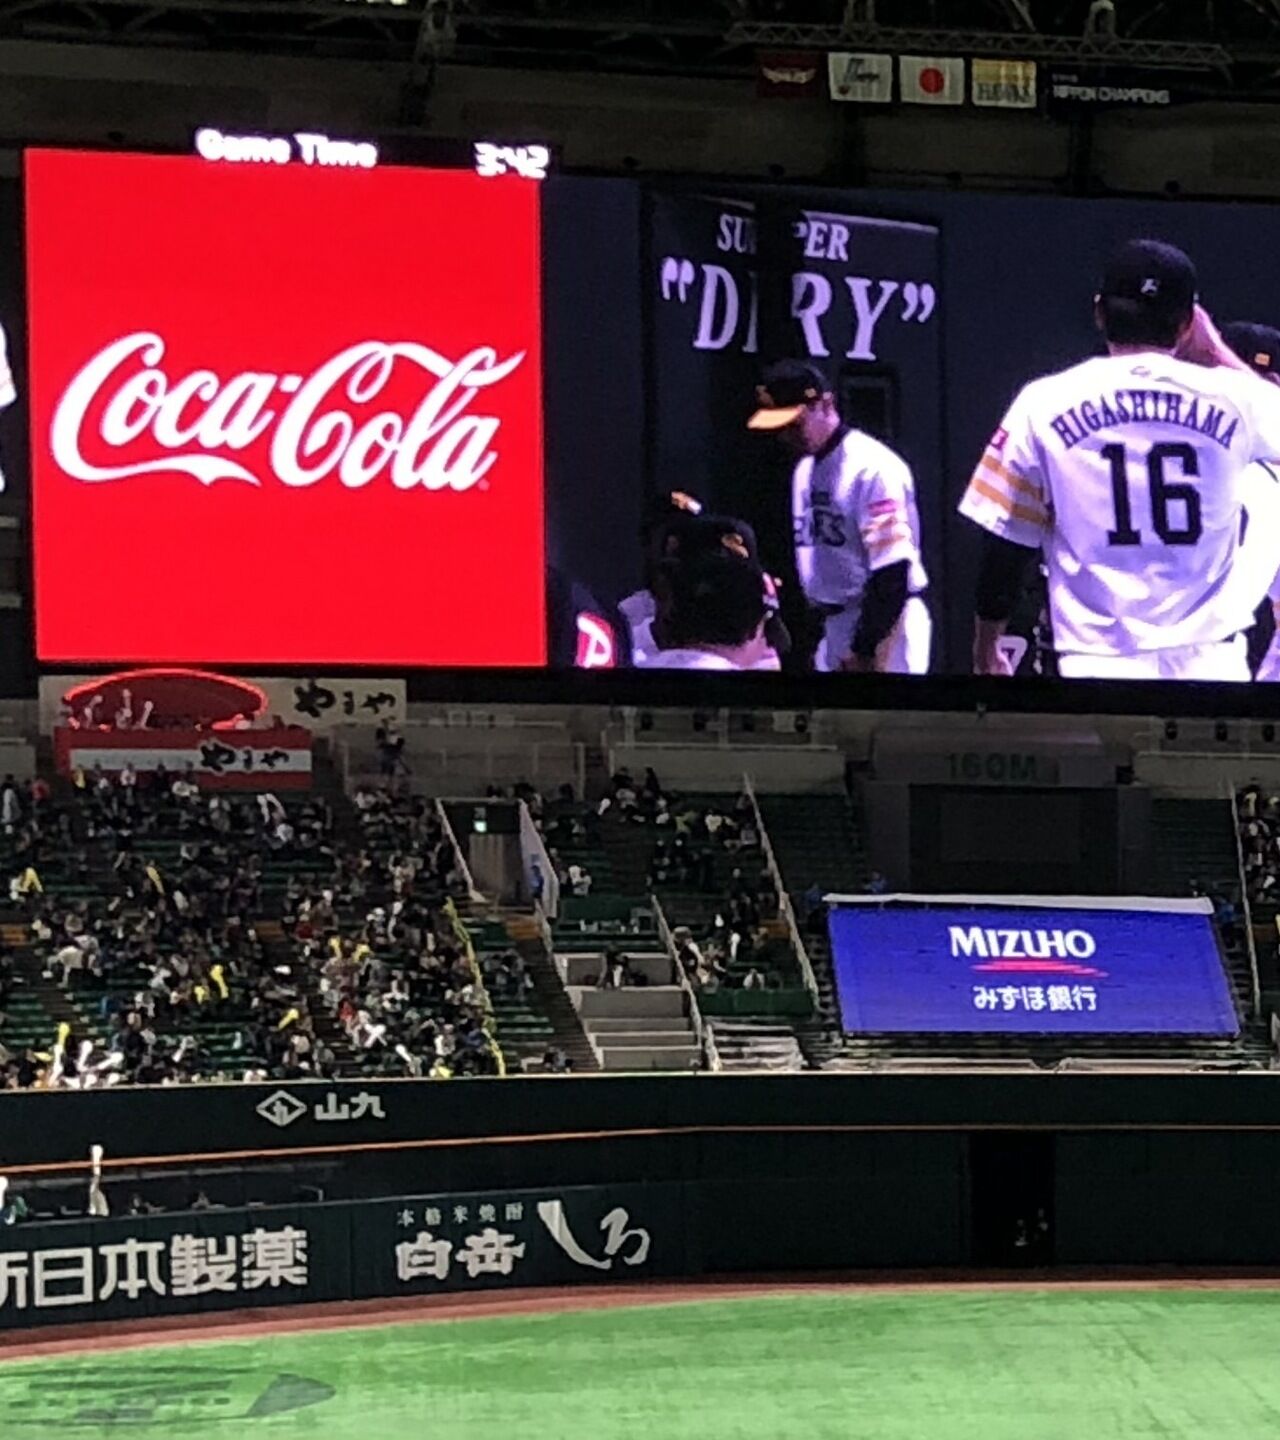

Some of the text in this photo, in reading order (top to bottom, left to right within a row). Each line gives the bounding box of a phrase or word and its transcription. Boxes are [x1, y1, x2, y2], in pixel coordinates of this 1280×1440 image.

[197, 128, 550, 180] Game Time 3:42
[1050, 389, 1239, 449] HIGASHIHAMA
[1101, 442, 1200, 546] 16
[949, 926, 1096, 958] MIZUHO
[973, 986, 1097, 1011] みずほ銀行
[315, 1091, 386, 1120] 山九
[395, 1228, 525, 1281] 白岳
[537, 1200, 650, 1269] しろ
